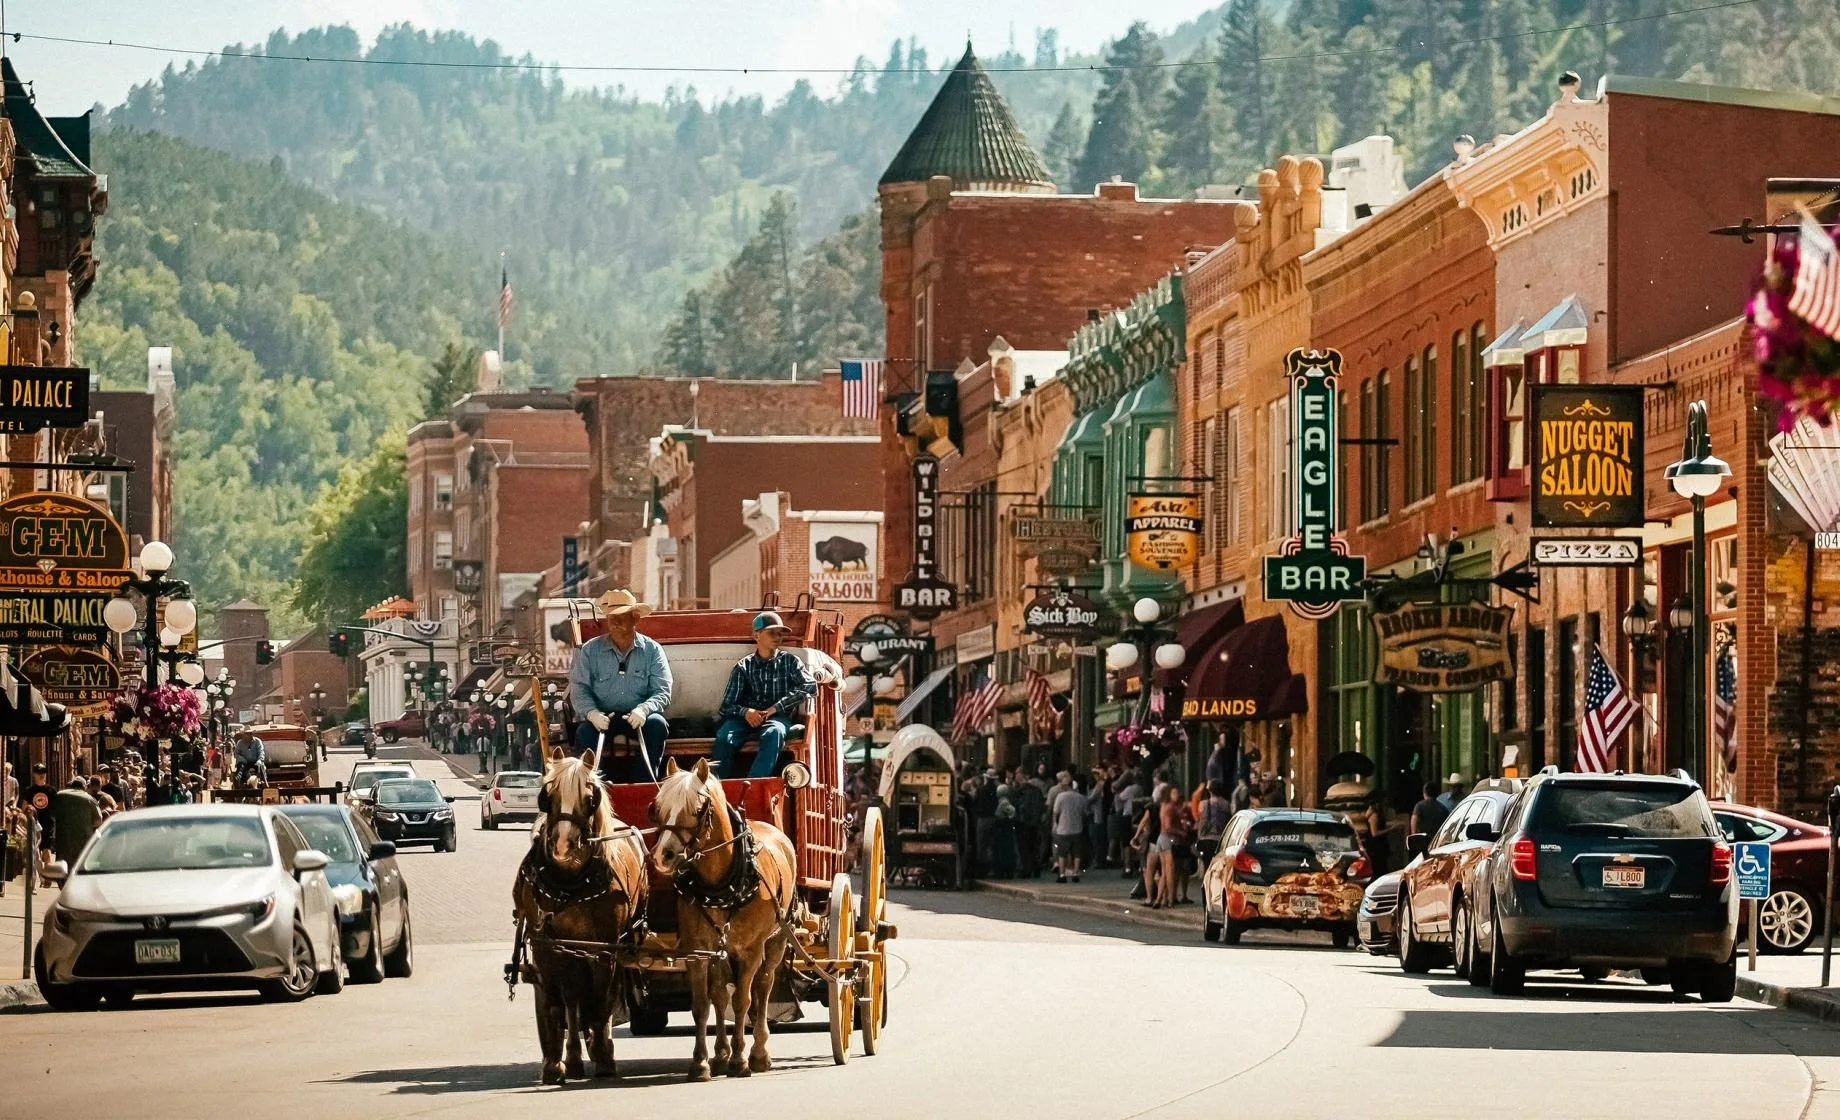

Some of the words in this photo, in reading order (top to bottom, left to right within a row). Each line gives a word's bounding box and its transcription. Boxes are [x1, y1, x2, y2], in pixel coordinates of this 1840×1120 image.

[12, 379, 73, 408] PALACE
[1541, 420, 1633, 464] NUGGET
[1303, 395, 1327, 549] EAGLE
[1541, 453, 1632, 496] SALOON
[917, 462, 933, 518] WILD
[1133, 516, 1197, 531] APPAREL
[11, 516, 106, 558] GEM
[917, 524, 933, 579] BILL
[1540, 544, 1635, 559] PIZZA
[58, 570, 73, 586] &
[812, 582, 873, 599] SALOON
[1280, 565, 1351, 591] BAR
[900, 588, 951, 606] BAR
[54, 598, 105, 626] PALACE
[1027, 605, 1064, 625] Sick
[1065, 607, 1098, 627] Boy
[27, 629, 64, 638] ROULETTE
[73, 632, 97, 641] CARDS
[43, 661, 110, 687] GEM
[1202, 699, 1256, 716] LANDS
[1255, 834, 1300, 844] 605-578-1422
